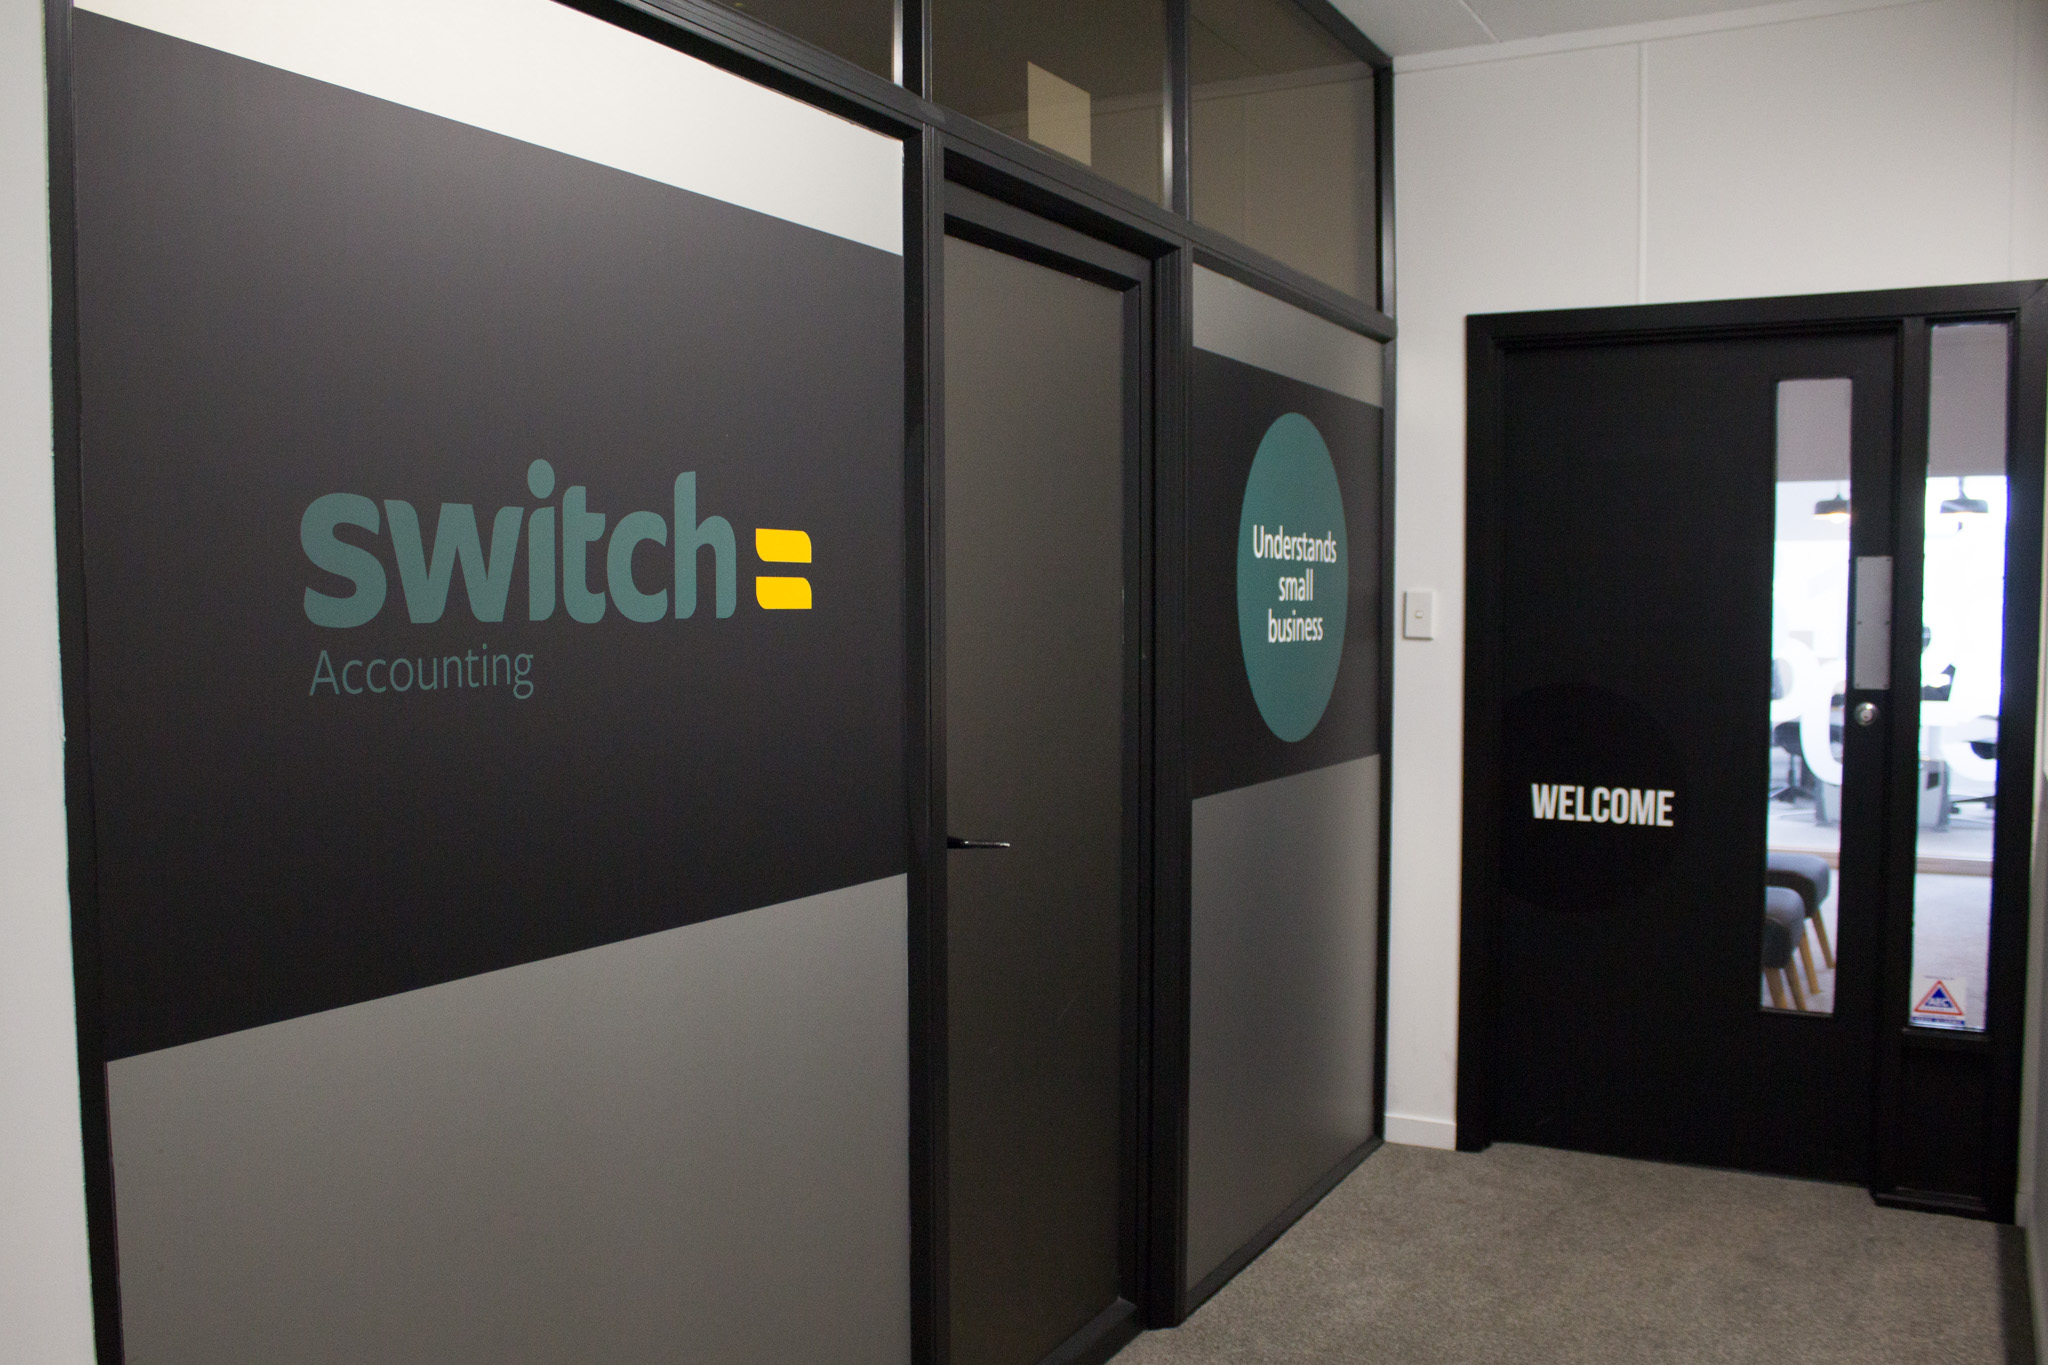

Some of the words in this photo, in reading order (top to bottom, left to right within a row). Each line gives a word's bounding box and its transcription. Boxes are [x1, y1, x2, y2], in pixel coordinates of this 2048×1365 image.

[1252, 523, 1338, 563] Understands
[1278, 567, 1314, 602] small
[1267, 607, 1324, 643] business
[308, 643, 535, 699] Accounting
[1530, 782, 1676, 828] WELCOME
